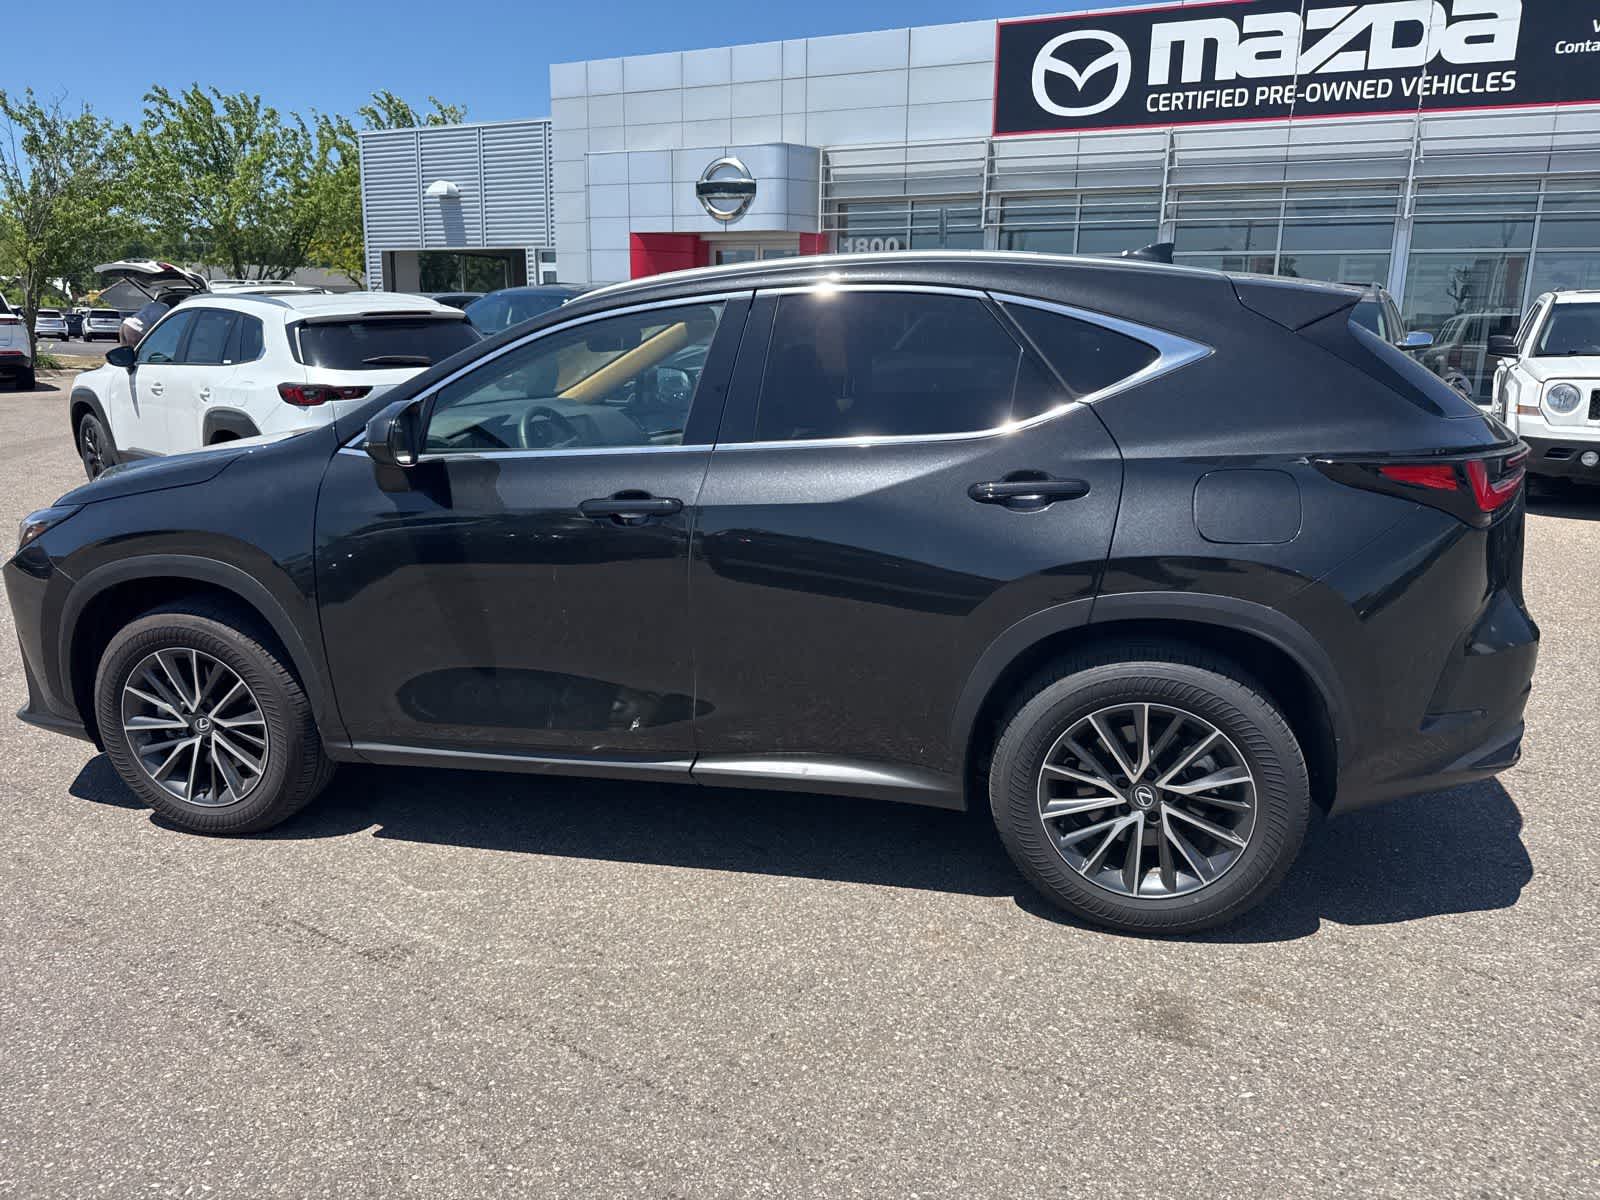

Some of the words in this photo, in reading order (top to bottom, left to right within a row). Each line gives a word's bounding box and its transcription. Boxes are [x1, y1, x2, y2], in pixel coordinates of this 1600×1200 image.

[1146, 87, 1249, 113] CERTIFIED
[1255, 78, 1393, 106] PRE-OWNED
[1401, 70, 1517, 97] VEHICLES
[844, 236, 899, 253] 1800
